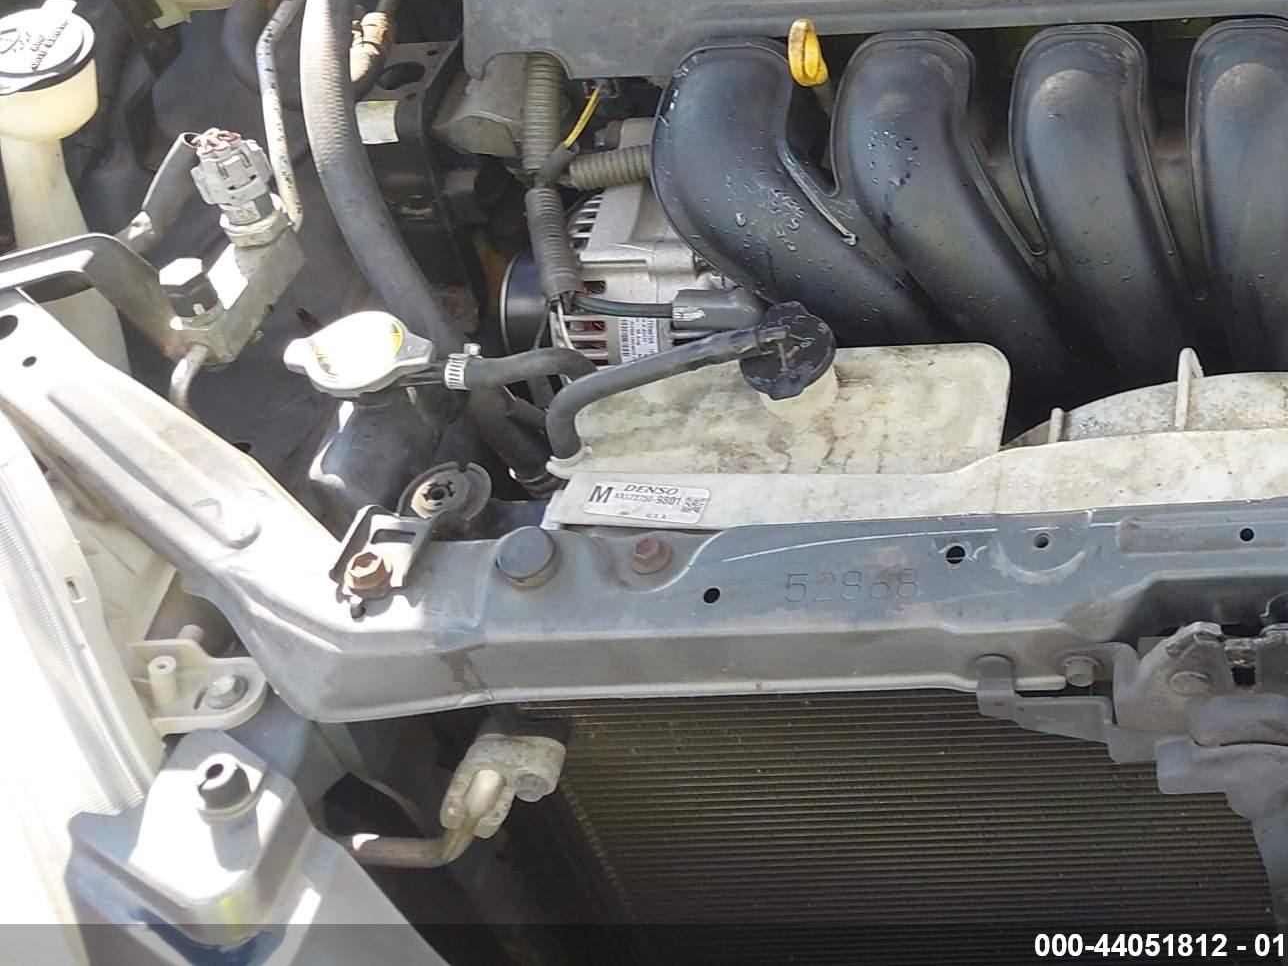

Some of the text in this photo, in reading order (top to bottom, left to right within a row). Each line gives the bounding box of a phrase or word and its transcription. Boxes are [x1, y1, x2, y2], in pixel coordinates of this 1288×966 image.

[588, 484, 679, 503] M DENSO
[783, 567, 920, 603] 52868
